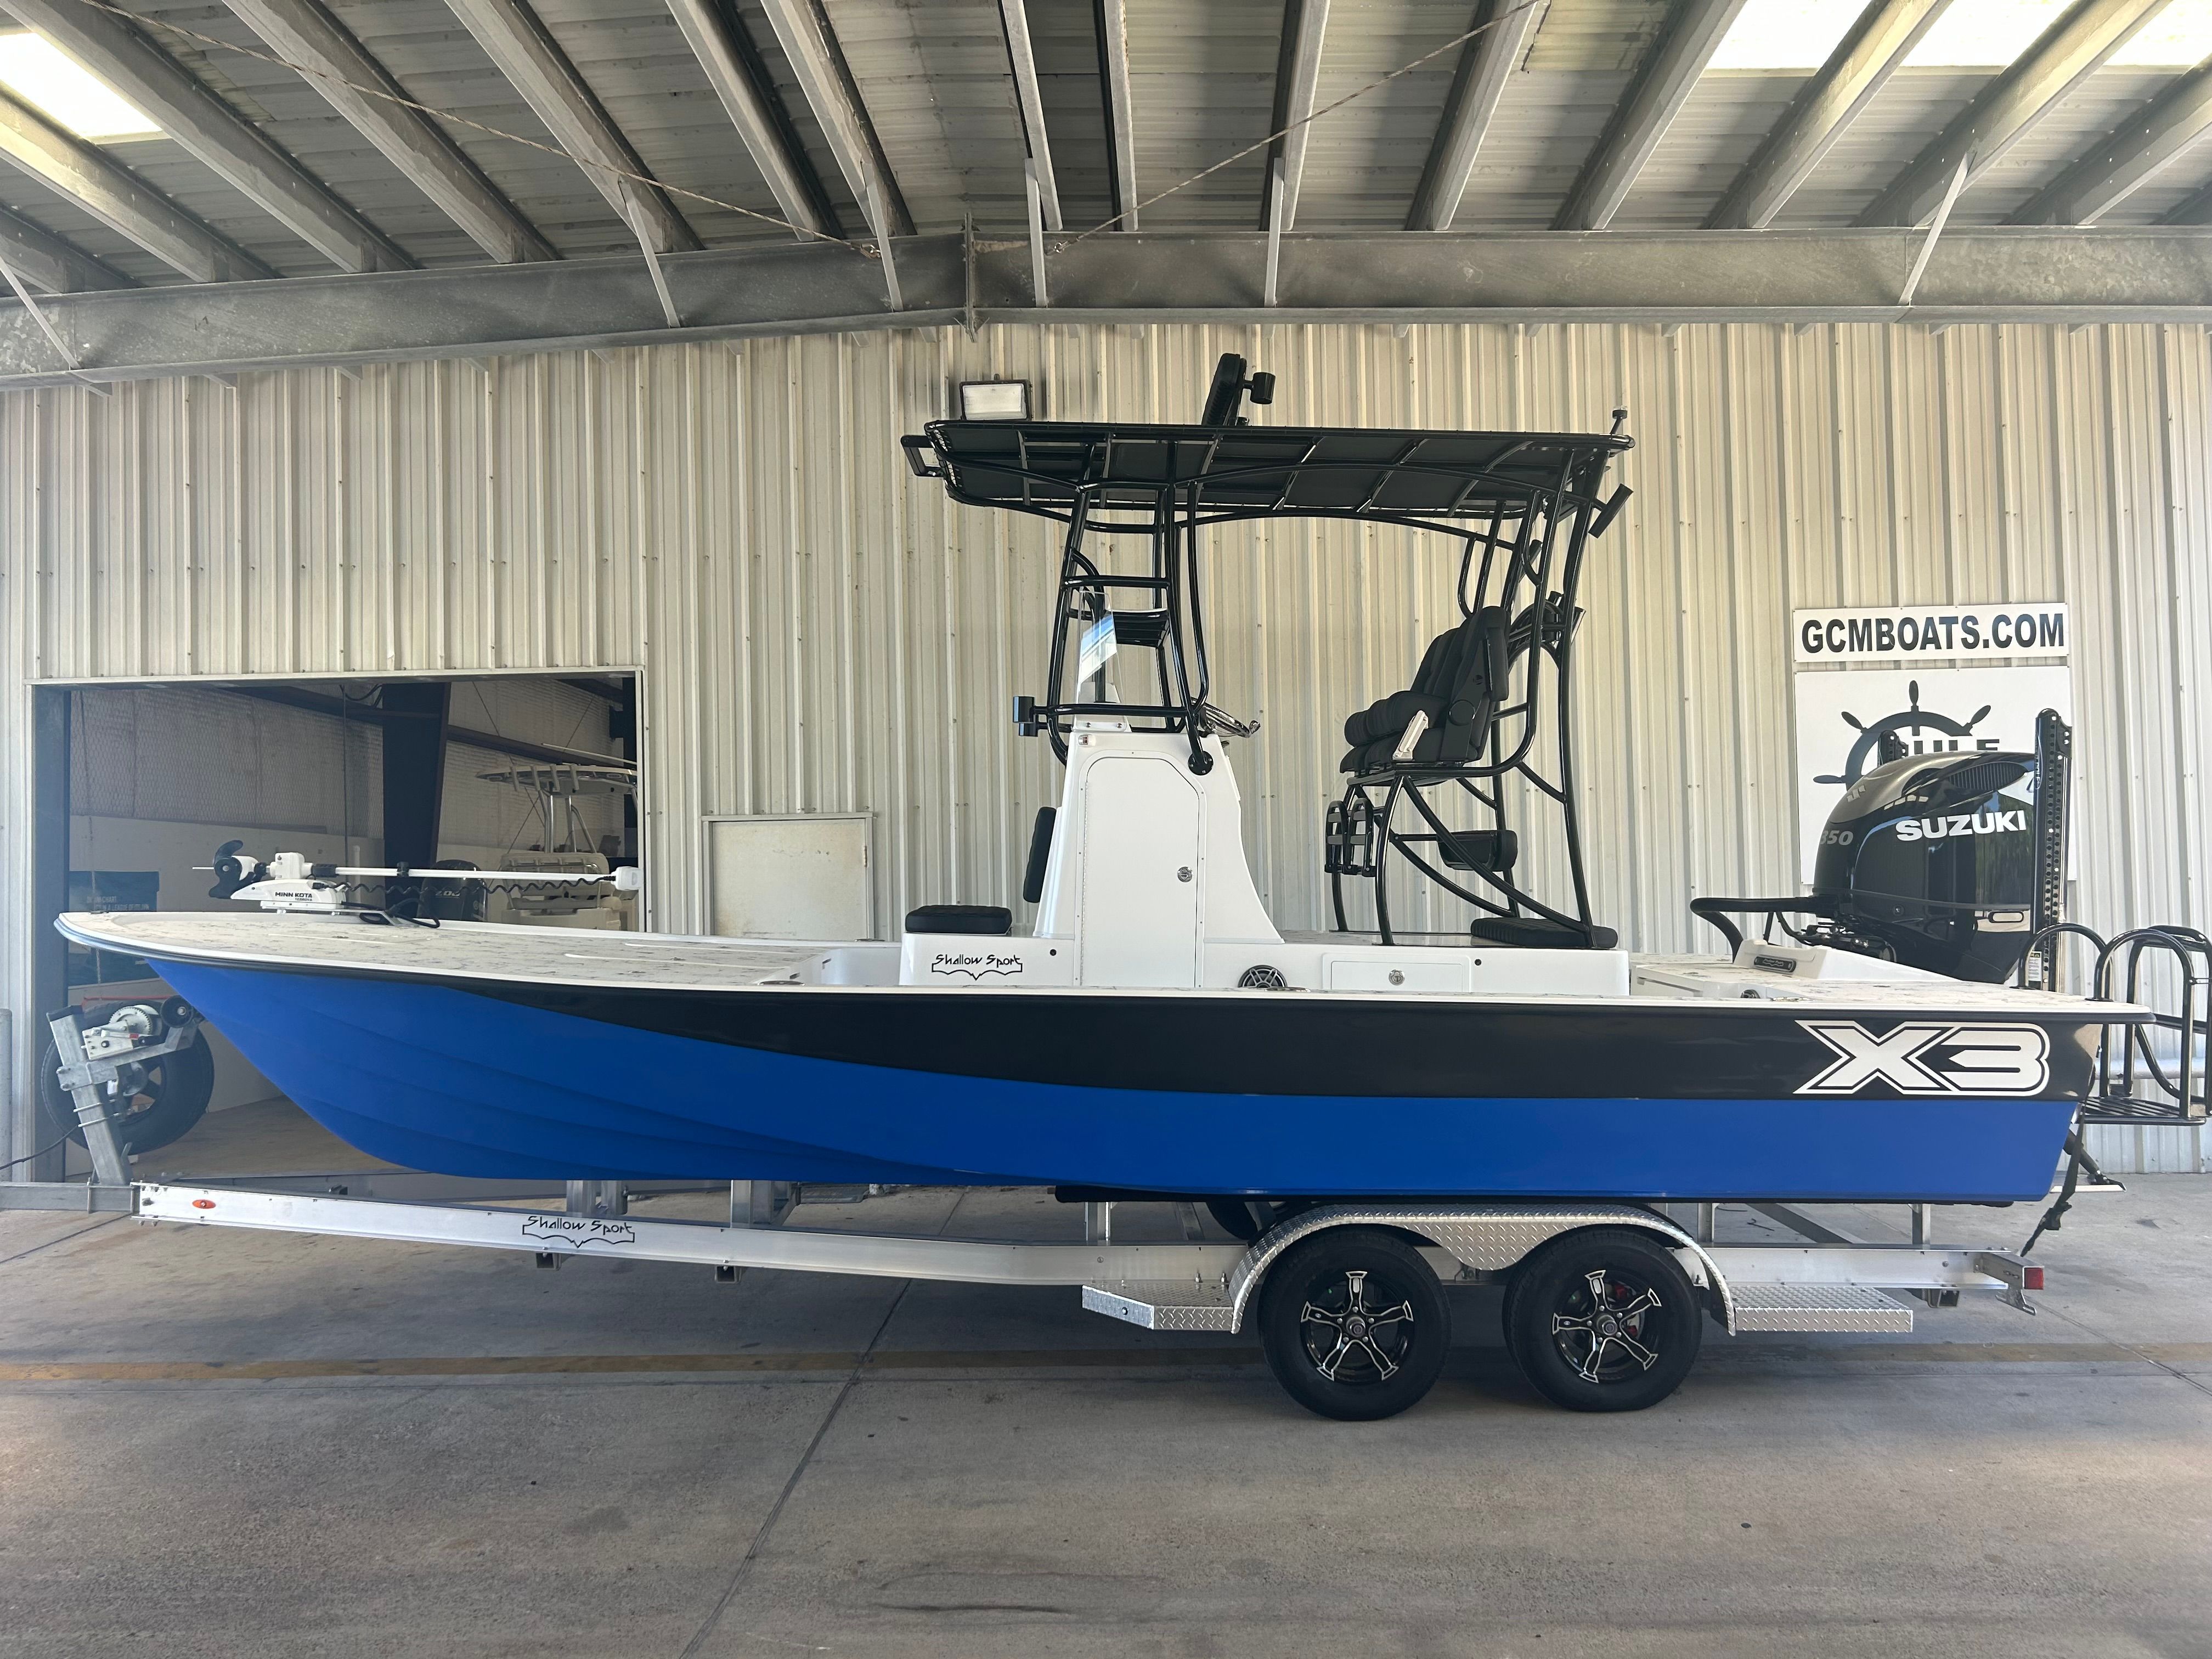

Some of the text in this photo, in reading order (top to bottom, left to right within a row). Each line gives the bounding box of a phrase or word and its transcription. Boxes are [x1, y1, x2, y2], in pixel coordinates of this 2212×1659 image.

[1801, 613, 2064, 653] GCMBOATS.COM
[1896, 810, 2027, 841] SUZUKI
[935, 953, 1021, 968] Shallow Sport
[1793, 1020, 2051, 1096] X3
[528, 1216, 633, 1235] Shallow Sport
